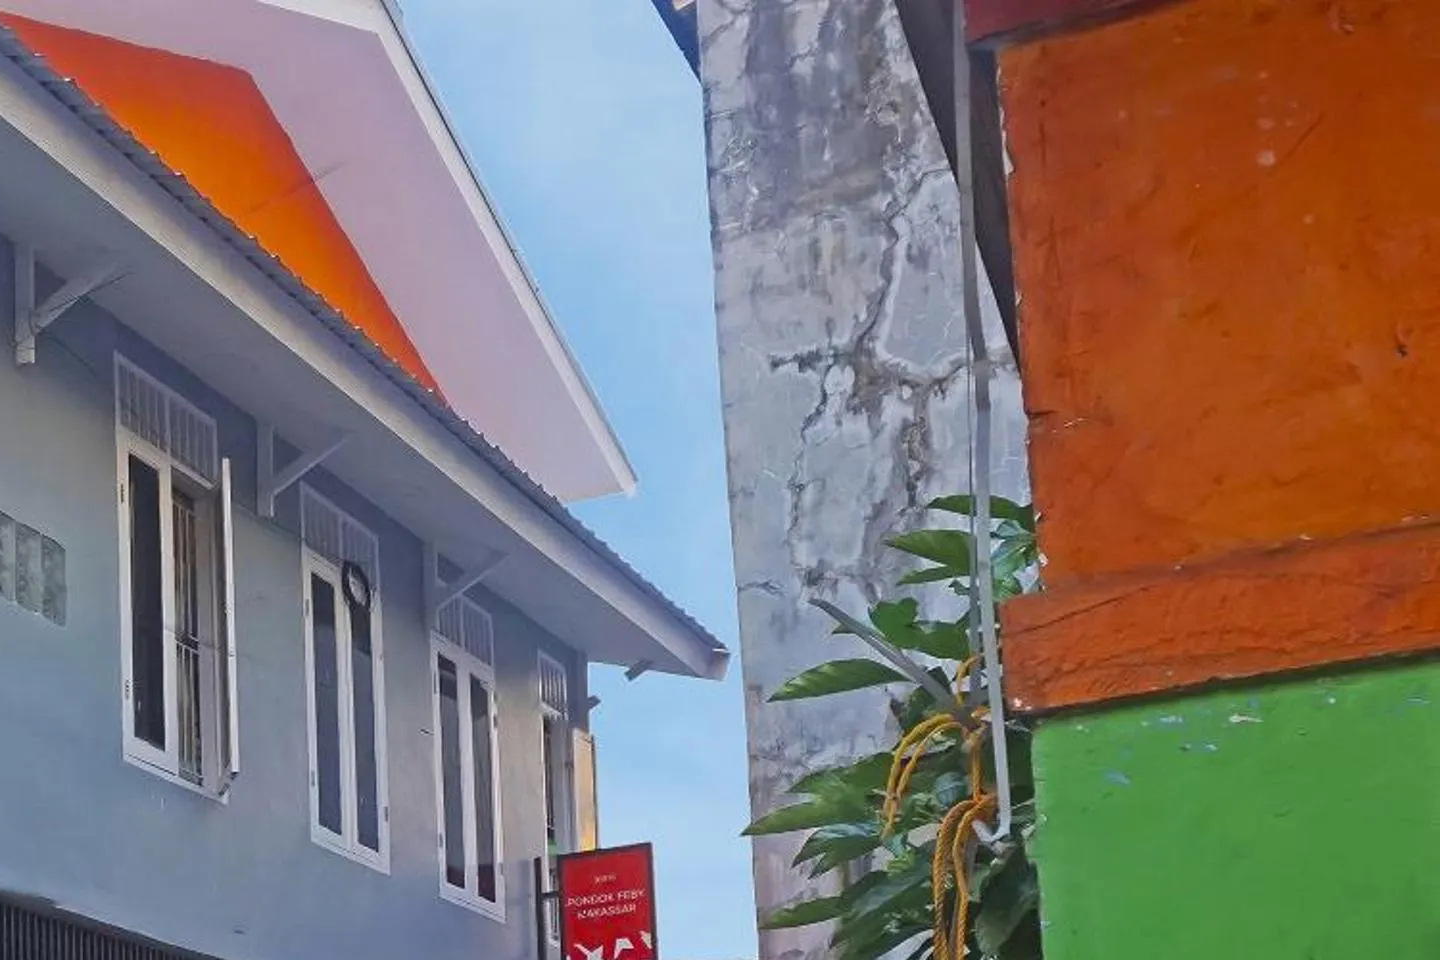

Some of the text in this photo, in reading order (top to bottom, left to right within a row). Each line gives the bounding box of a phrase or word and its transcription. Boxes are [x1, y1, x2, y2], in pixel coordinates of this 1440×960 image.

[566, 889, 645, 907] PONDOK FEBY
[576, 903, 637, 920] MAKASSAR
